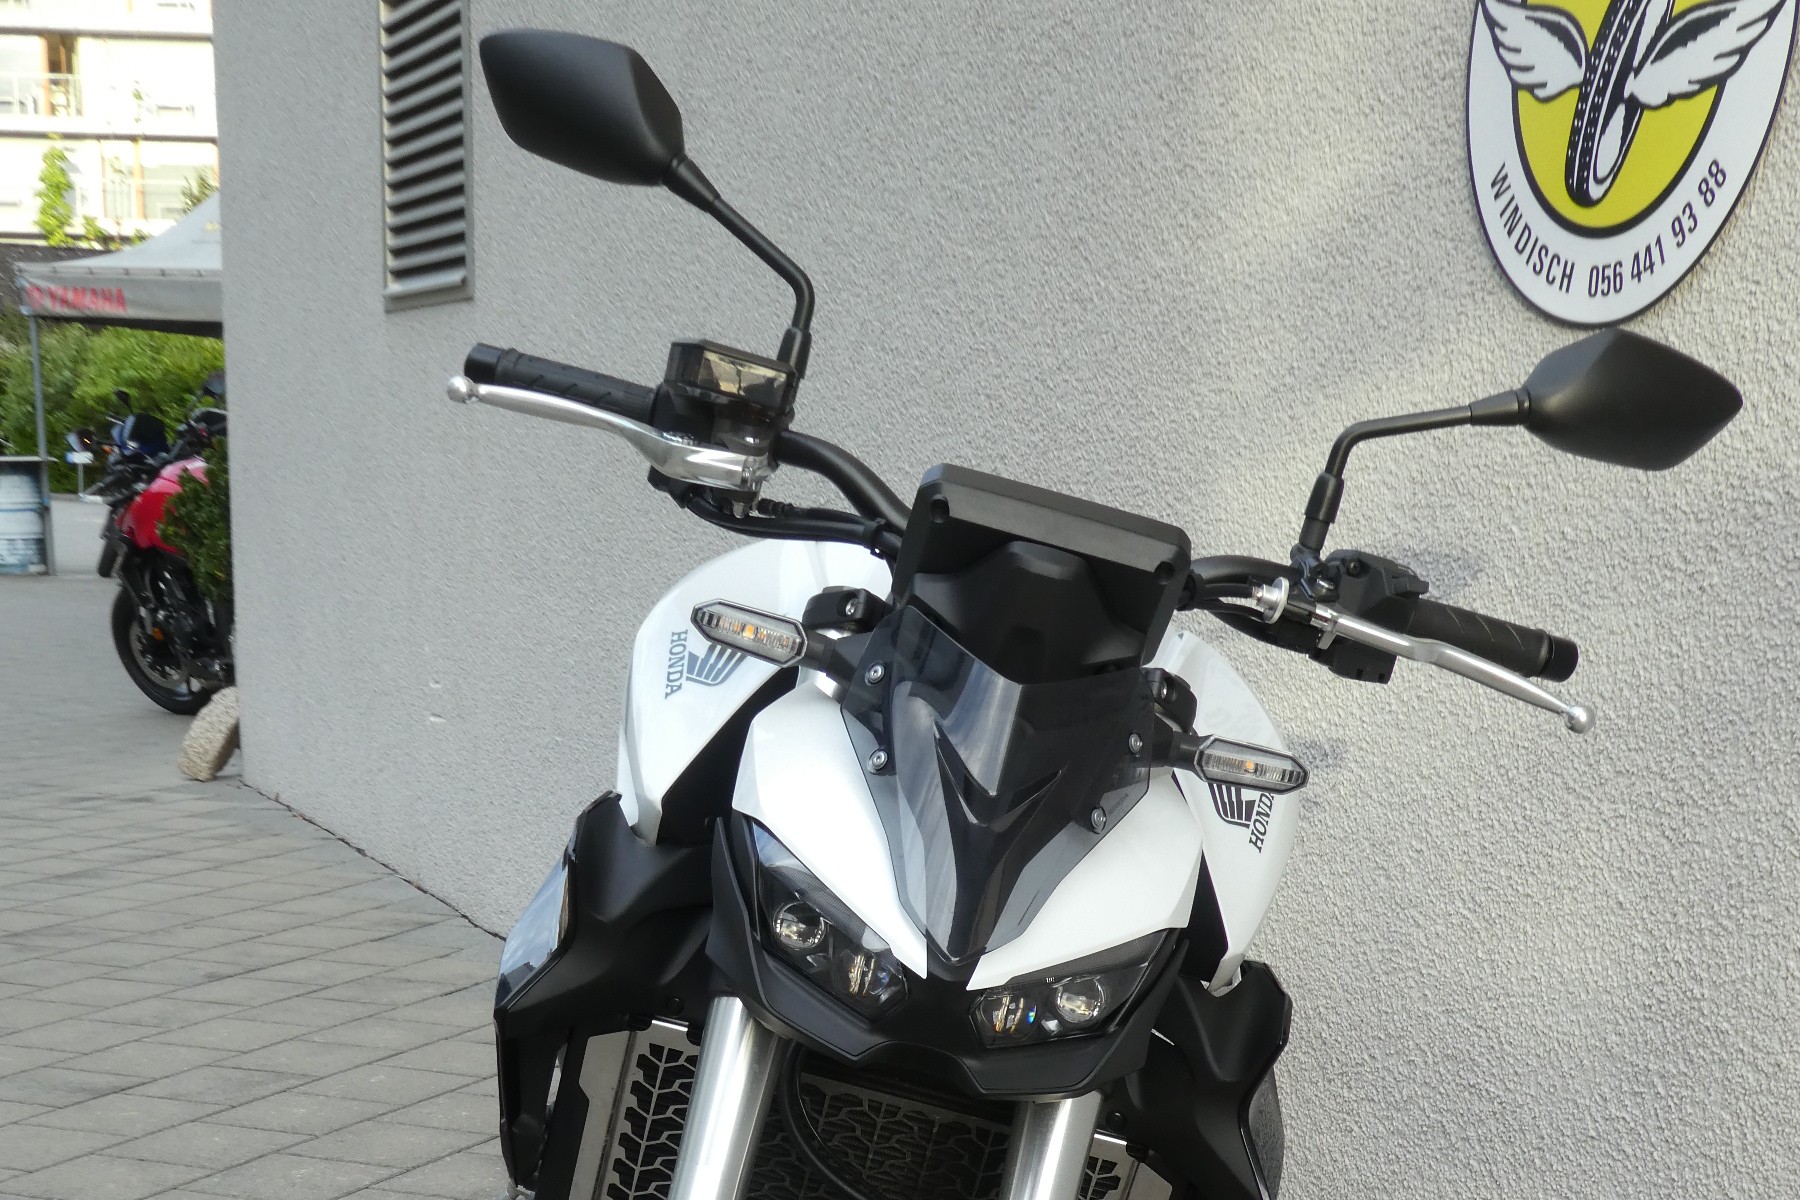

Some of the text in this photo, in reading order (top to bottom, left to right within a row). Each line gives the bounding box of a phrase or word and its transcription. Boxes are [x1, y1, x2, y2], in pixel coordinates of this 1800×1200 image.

[1490, 158, 1727, 298] WINDISCH 056 441 93 88
[46, 285, 127, 312] YAMAHA
[664, 629, 689, 700] HONDA
